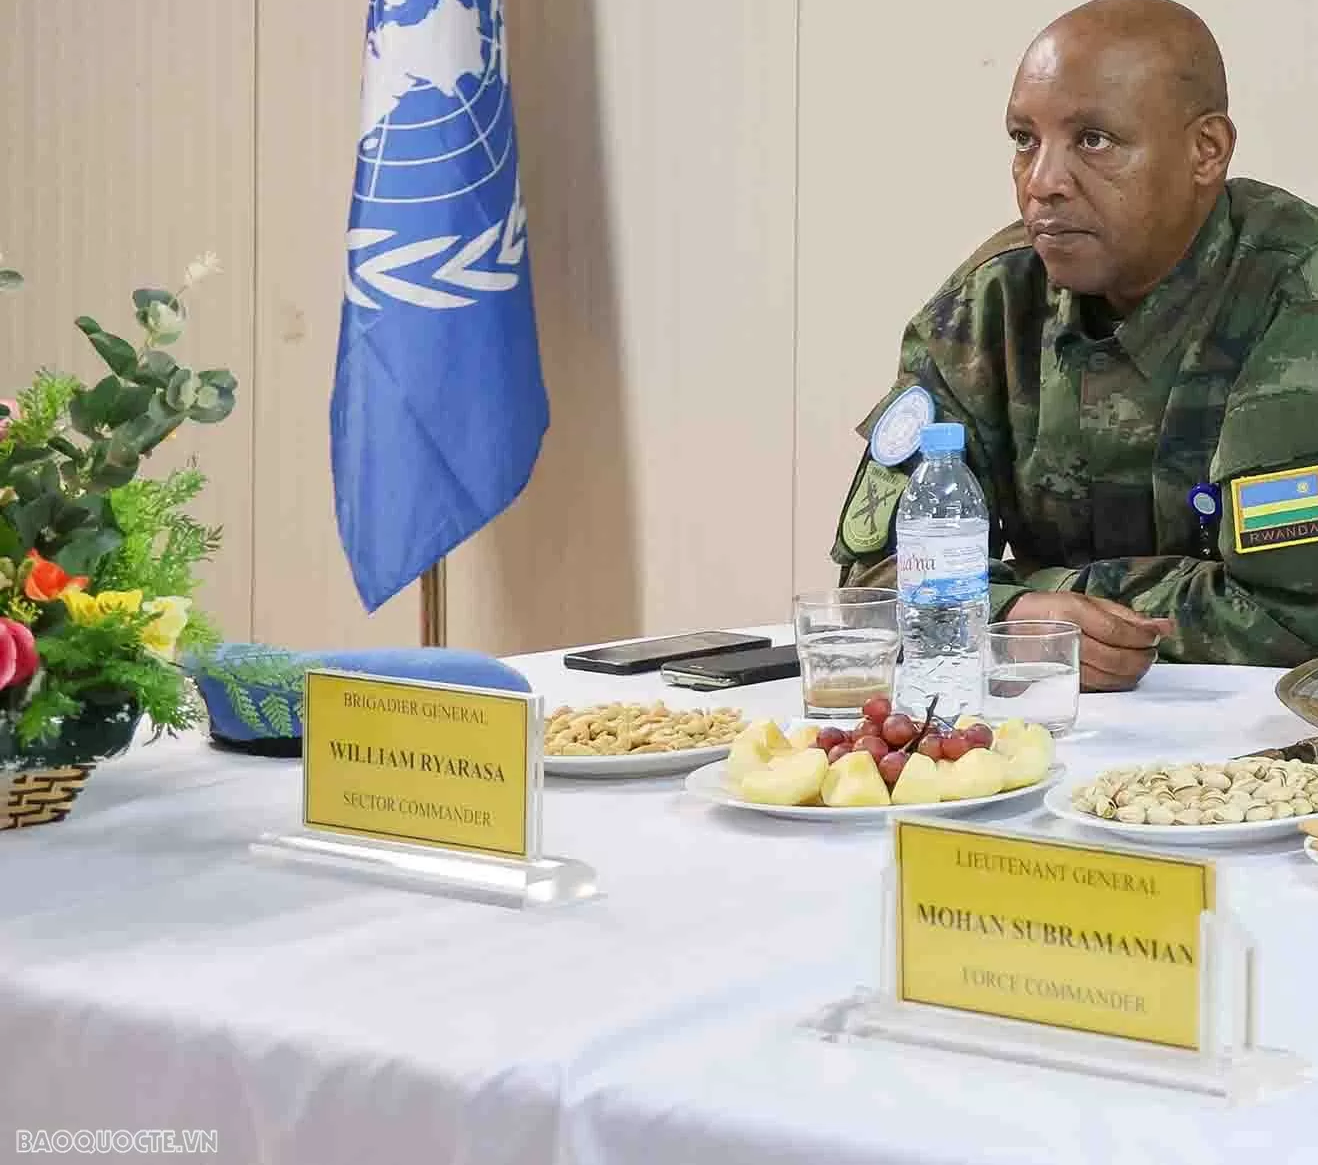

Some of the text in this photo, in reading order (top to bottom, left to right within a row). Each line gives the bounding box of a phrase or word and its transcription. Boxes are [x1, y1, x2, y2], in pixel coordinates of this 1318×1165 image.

[343, 691, 489, 726] BRIGADIER GENERAL
[329, 739, 506, 784] WILLIAM RYARASA
[342, 791, 492, 827] SECTOR COMMANDER
[954, 847, 1161, 897] LIEUTENANT GENERAL
[916, 901, 1195, 965] MOHAN SUBRAMANIAN
[960, 965, 1148, 1013] FORCE COMMANDER
